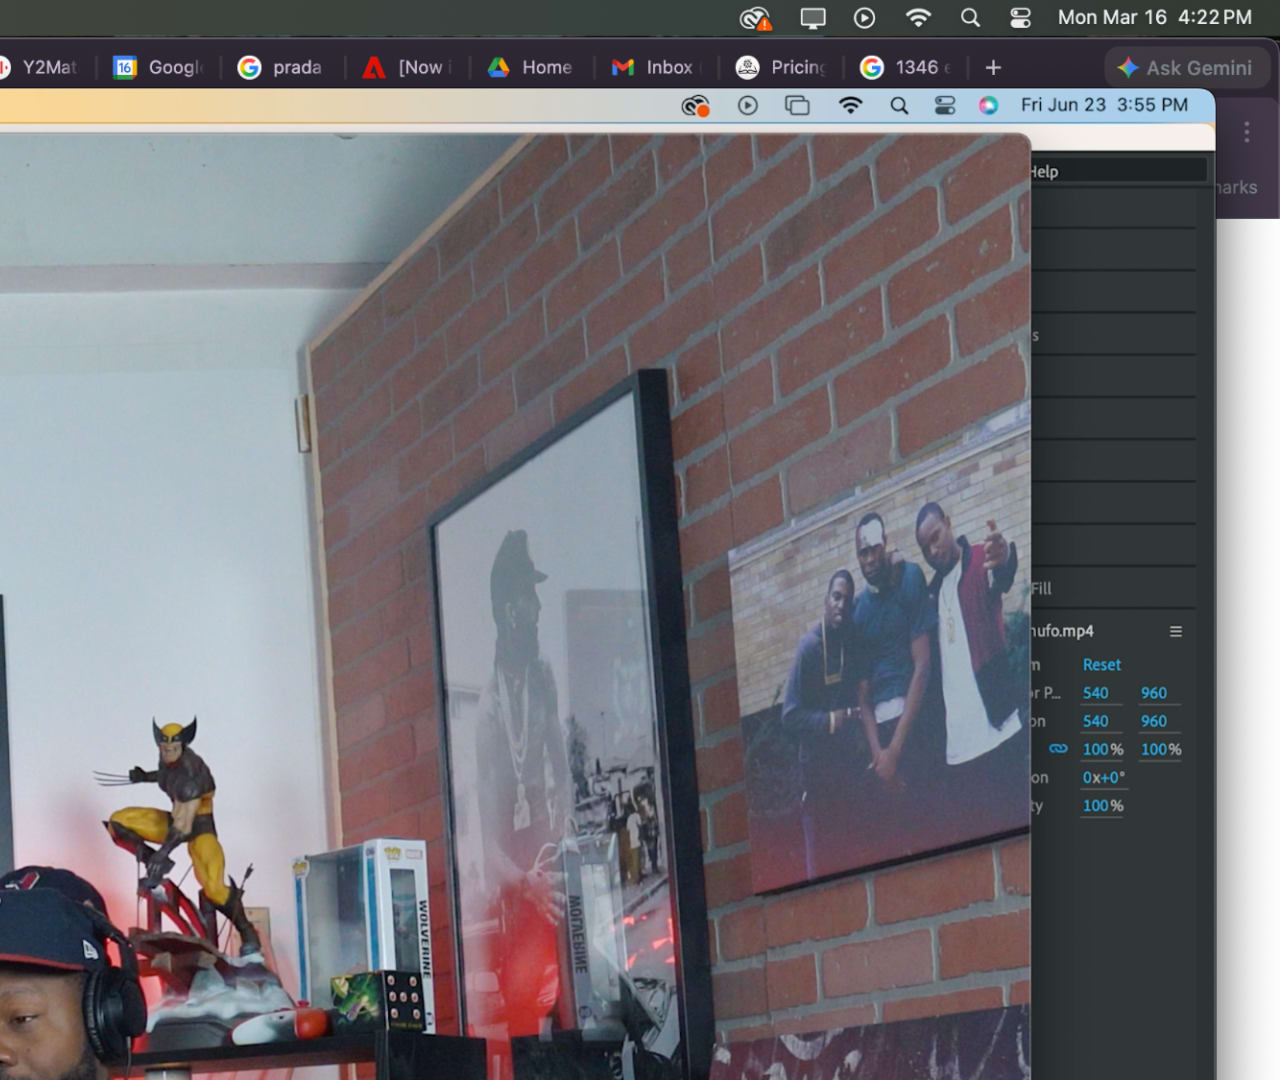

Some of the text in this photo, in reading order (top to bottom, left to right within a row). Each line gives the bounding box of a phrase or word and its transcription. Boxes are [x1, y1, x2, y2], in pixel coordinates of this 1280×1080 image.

[1059, 9, 1251, 24] Mon Mar 16 4:22 PM
[23, 59, 77, 74] Y2Mat
[274, 59, 321, 78] prada
[399, 59, 443, 78] [Now
[523, 60, 572, 74] Home
[648, 59, 693, 74] Inbox
[896, 59, 939, 75] 1346
[1147, 60, 1251, 76] Ask Gemini
[1022, 97, 1188, 112] Fri Jun 23 3:55 PM
[1083, 658, 1121, 671] Reset
[1083, 686, 1108, 699] 540
[1141, 687, 1167, 699] 960
[1084, 714, 1167, 728] 540 960
[418, 899, 432, 979] WOLVERINE
